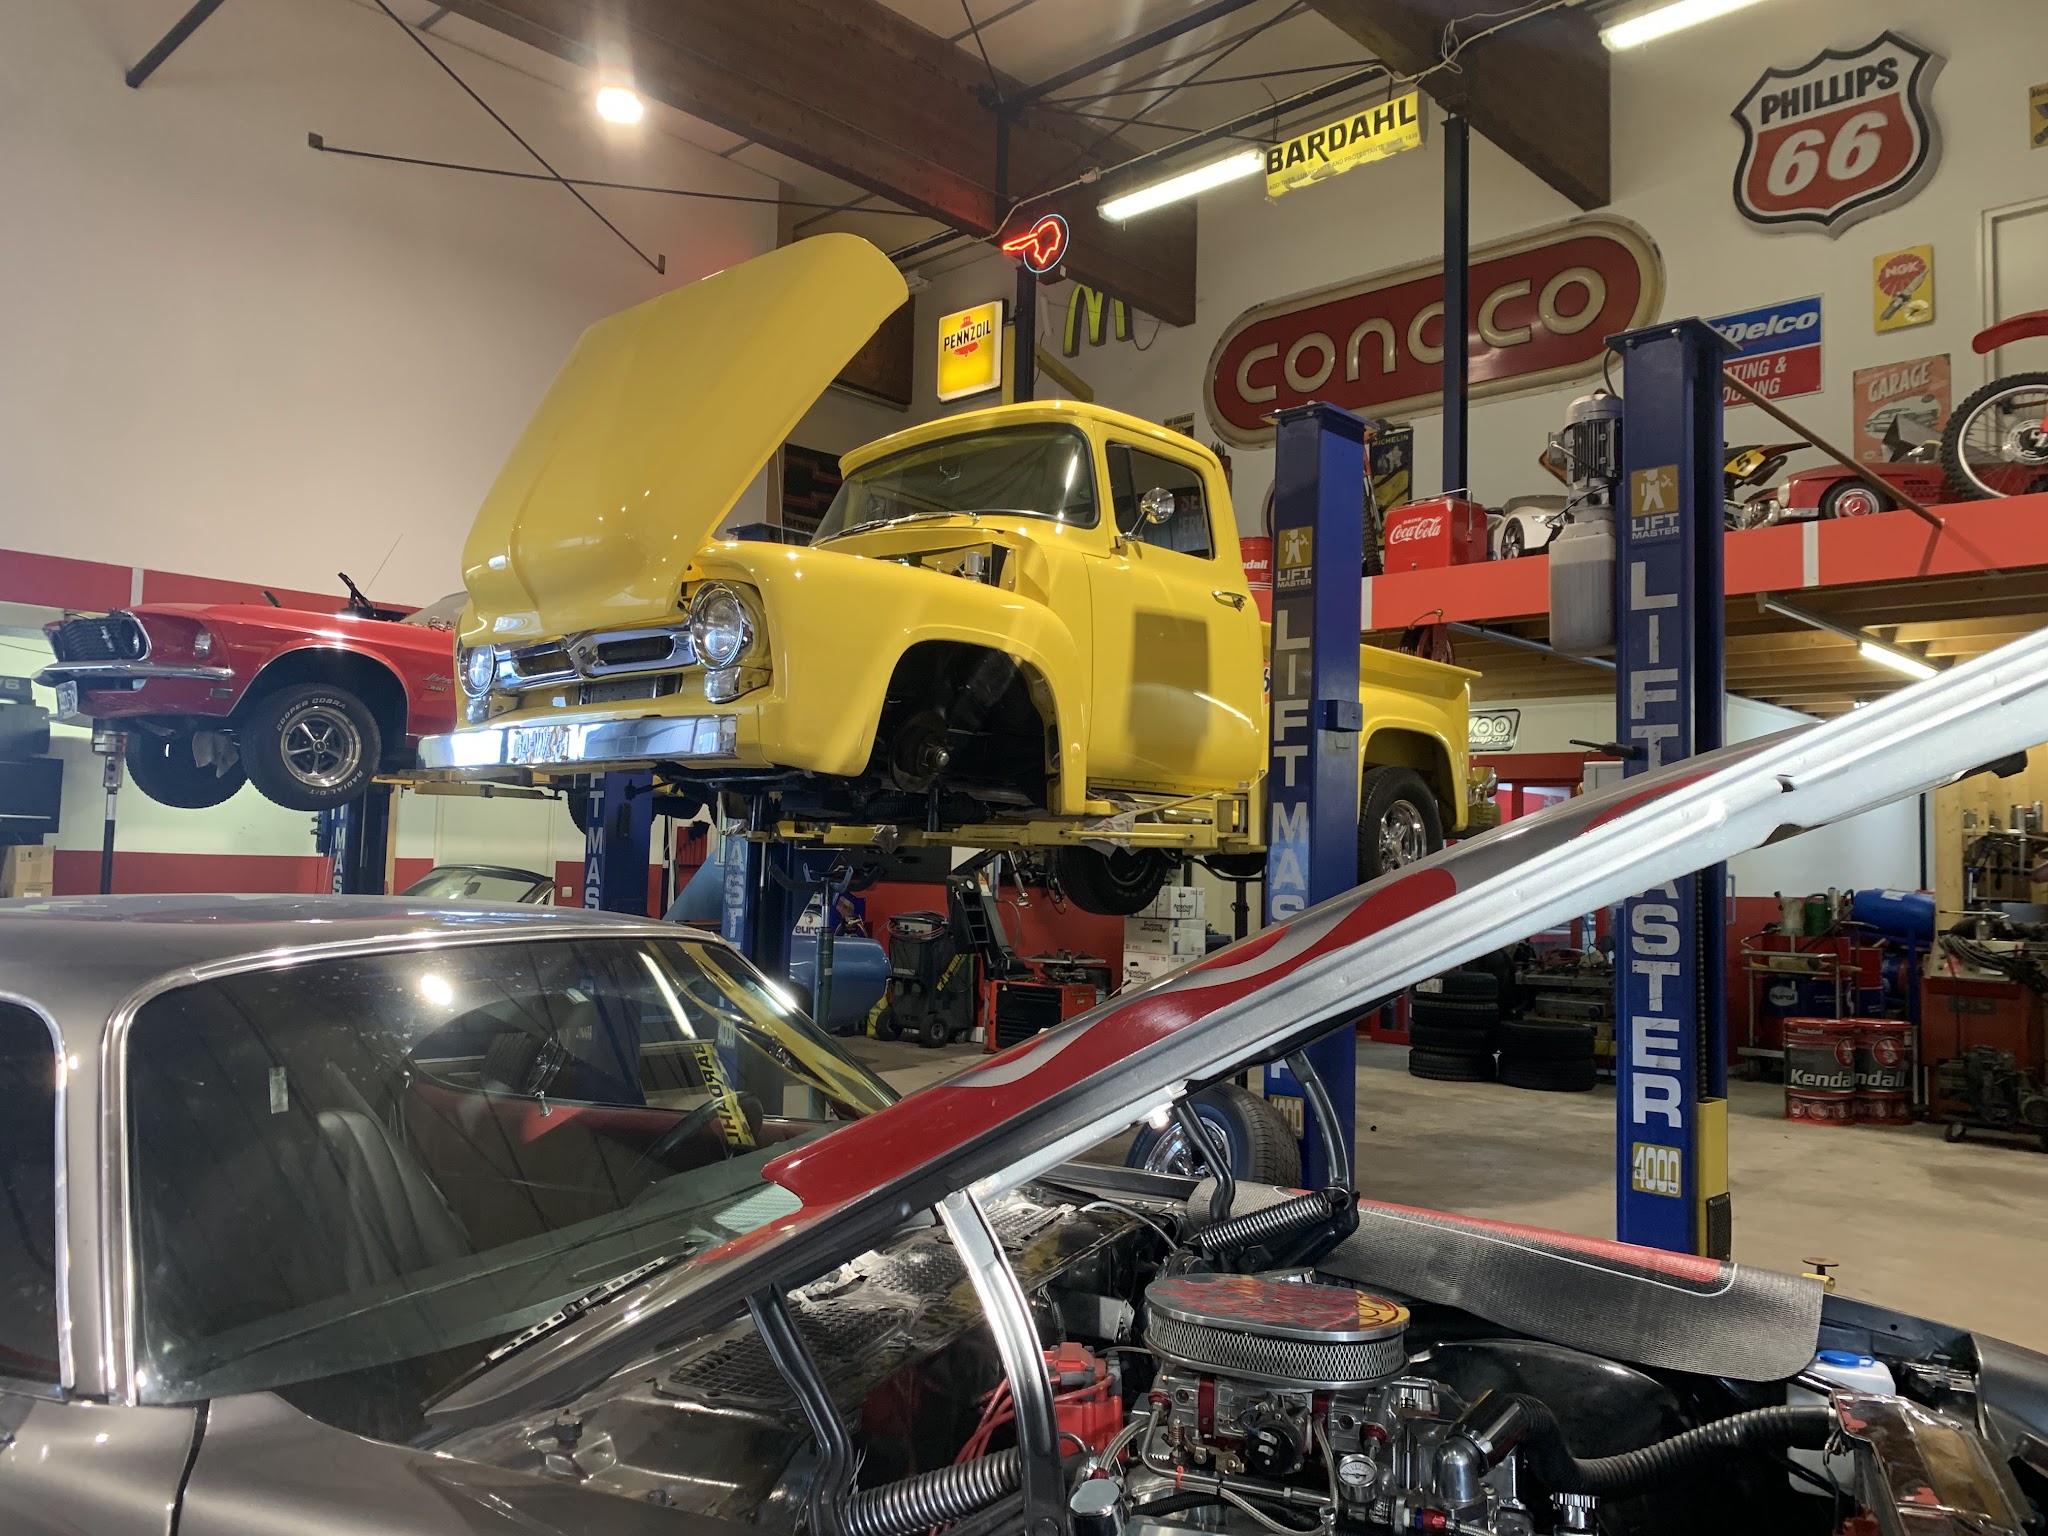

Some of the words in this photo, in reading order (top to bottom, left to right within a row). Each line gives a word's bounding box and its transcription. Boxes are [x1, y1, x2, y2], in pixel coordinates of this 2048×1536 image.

[1761, 57, 1898, 125] PHILLIPS
[1267, 98, 1416, 175] BARDAHL
[1767, 110, 1888, 197] 66
[1885, 260, 1919, 278] NGK
[943, 320, 992, 352] PENNZOIL
[1720, 312, 1818, 342] Delco
[1775, 356, 1787, 374] &
[1868, 361, 1932, 403] GARAGE
[1372, 433, 1409, 447] MICHELIN
[1735, 451, 1752, 469] 5
[1389, 516, 1443, 545] Coca-Cola
[1403, 516, 1422, 525] DRINK
[1632, 513, 1680, 532] LIFT
[1632, 526, 1680, 540] MASTER
[1243, 560, 1268, 570] ndall
[1277, 566, 1312, 582] LIFT
[1277, 578, 1312, 589] MASTER
[1631, 561, 1679, 768] LIFT
[1273, 609, 1310, 787] LIFT
[277, 700, 308, 731] COOPER
[312, 697, 346, 709] COBRA
[332, 827, 346, 894] MAS
[584, 827, 604, 910] MAS
[1271, 802, 1308, 922] MAS
[725, 840, 744, 939] AST
[795, 923, 820, 934] euro
[1632, 878, 1682, 1128] STER
[1790, 1068, 1855, 1088] Kenda
[1855, 1070, 1905, 1087] ndall
[1634, 1146, 1680, 1194] 4000
